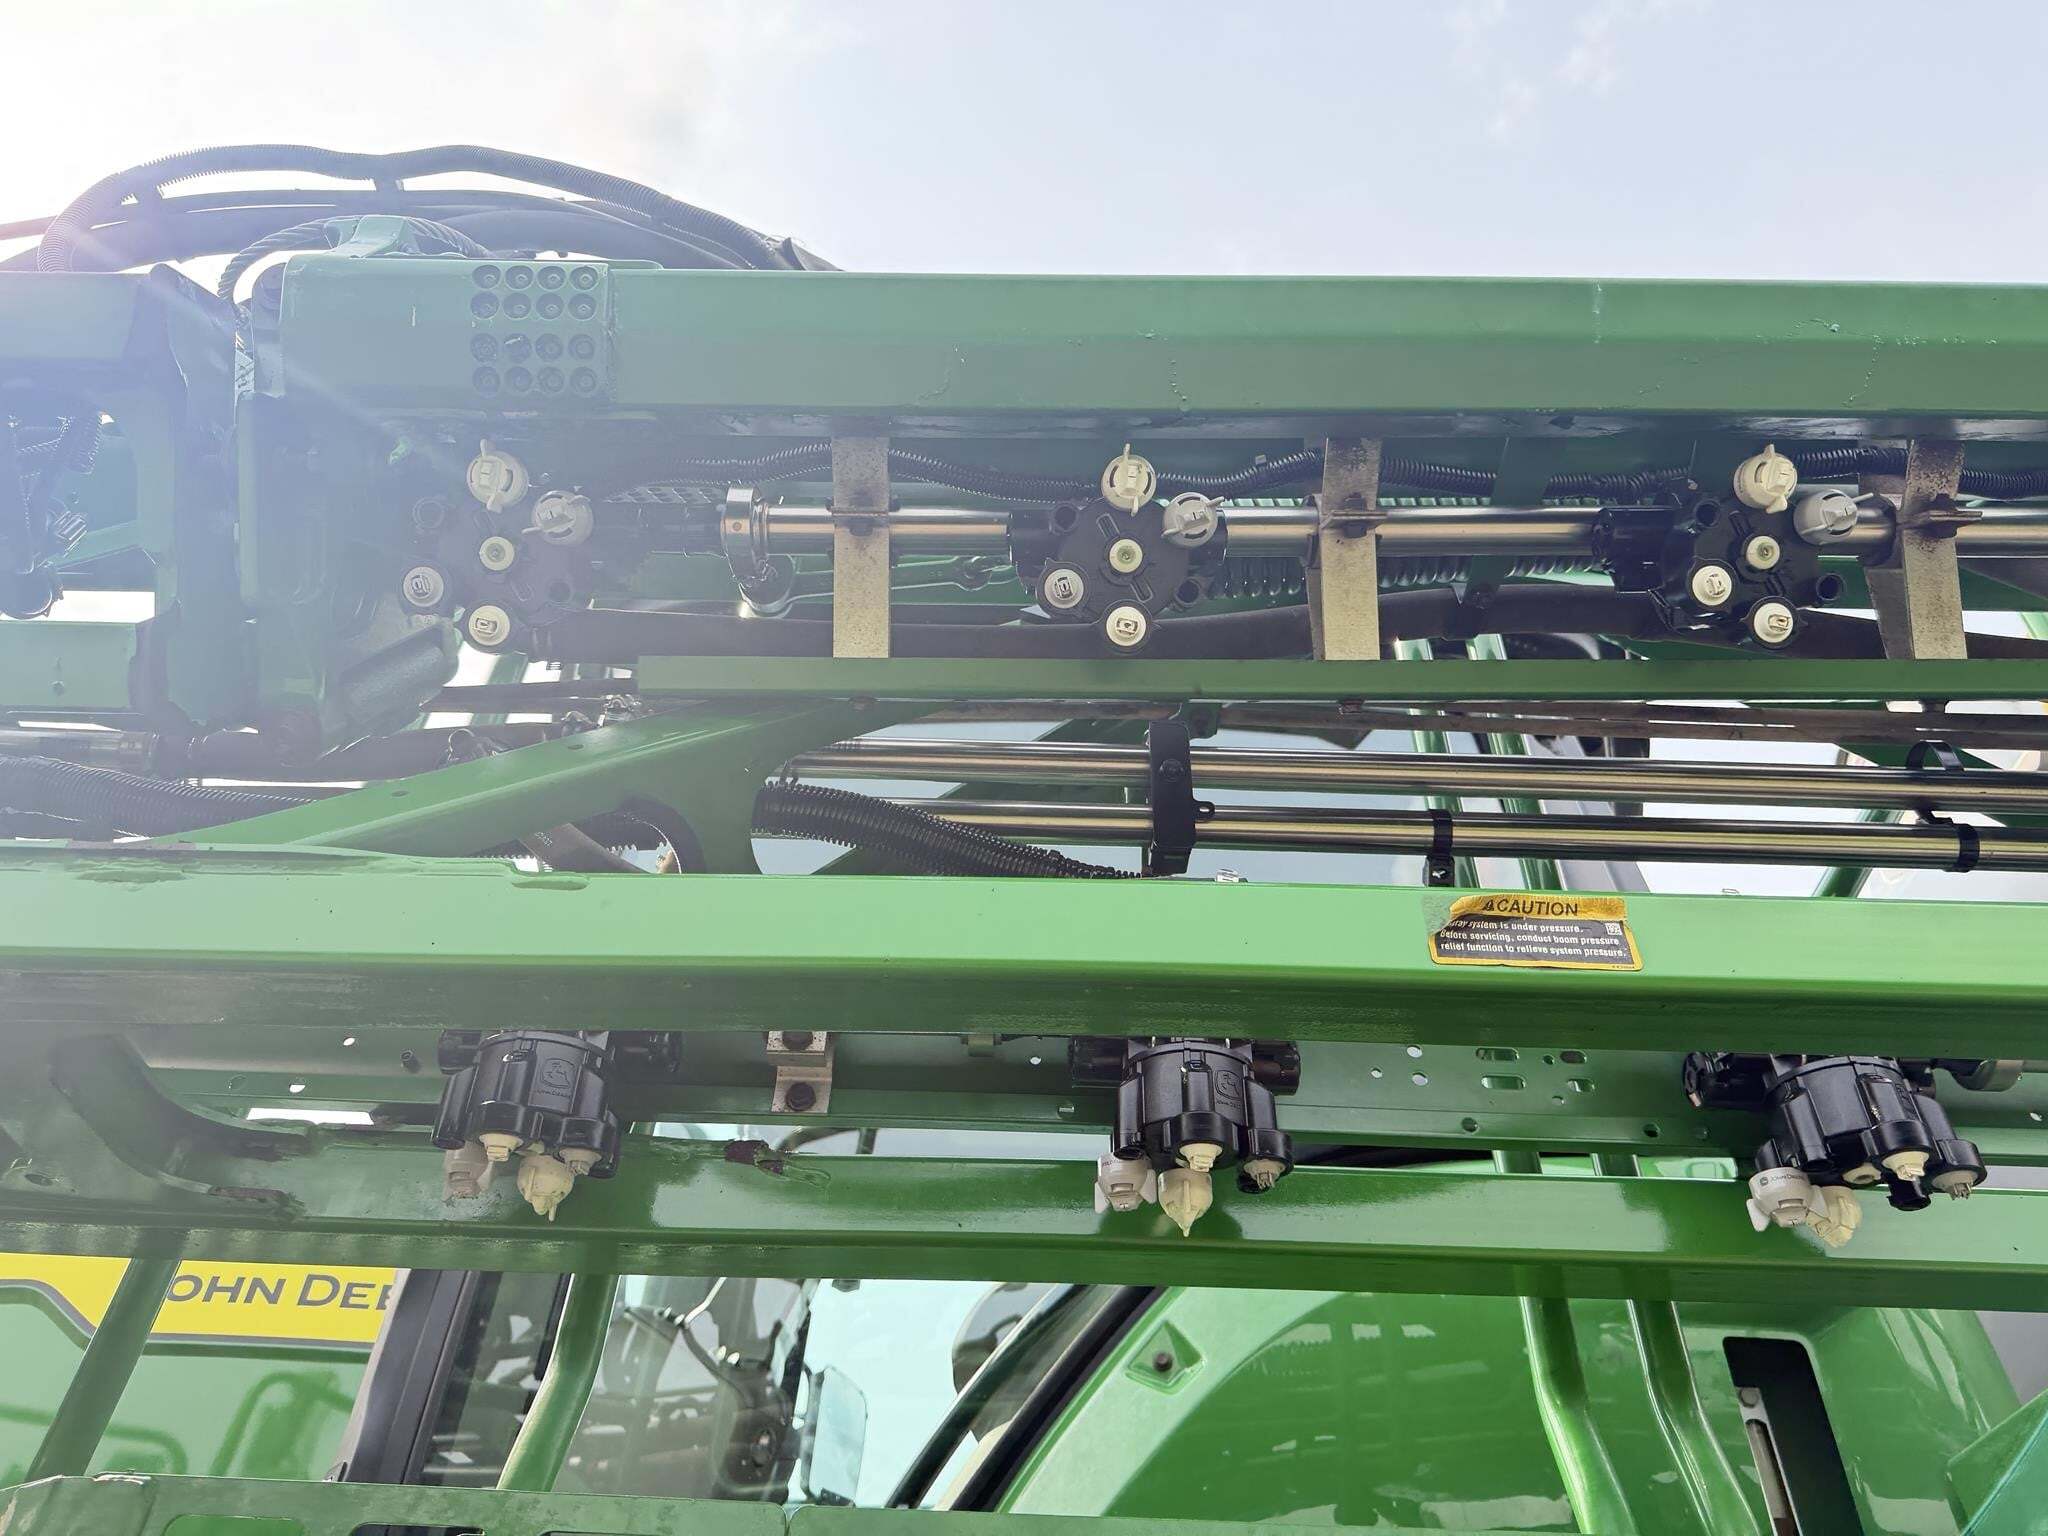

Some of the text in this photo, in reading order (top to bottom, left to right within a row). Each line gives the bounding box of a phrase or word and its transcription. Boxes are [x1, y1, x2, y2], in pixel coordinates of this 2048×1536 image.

[1497, 899, 1578, 916] CAUTION
[1468, 921, 1498, 930] system
[1500, 922, 1509, 930] is
[1511, 923, 1538, 931] under
[1540, 925, 1584, 935] pressure.
[1440, 930, 1468, 939] Before
[1516, 934, 1552, 943] conduct
[1553, 935, 1579, 944] boom
[1580, 937, 1620, 947] pressure
[1440, 942, 1627, 958] relief function to relieve system pressure.
[166, 1274, 287, 1305] OHN
